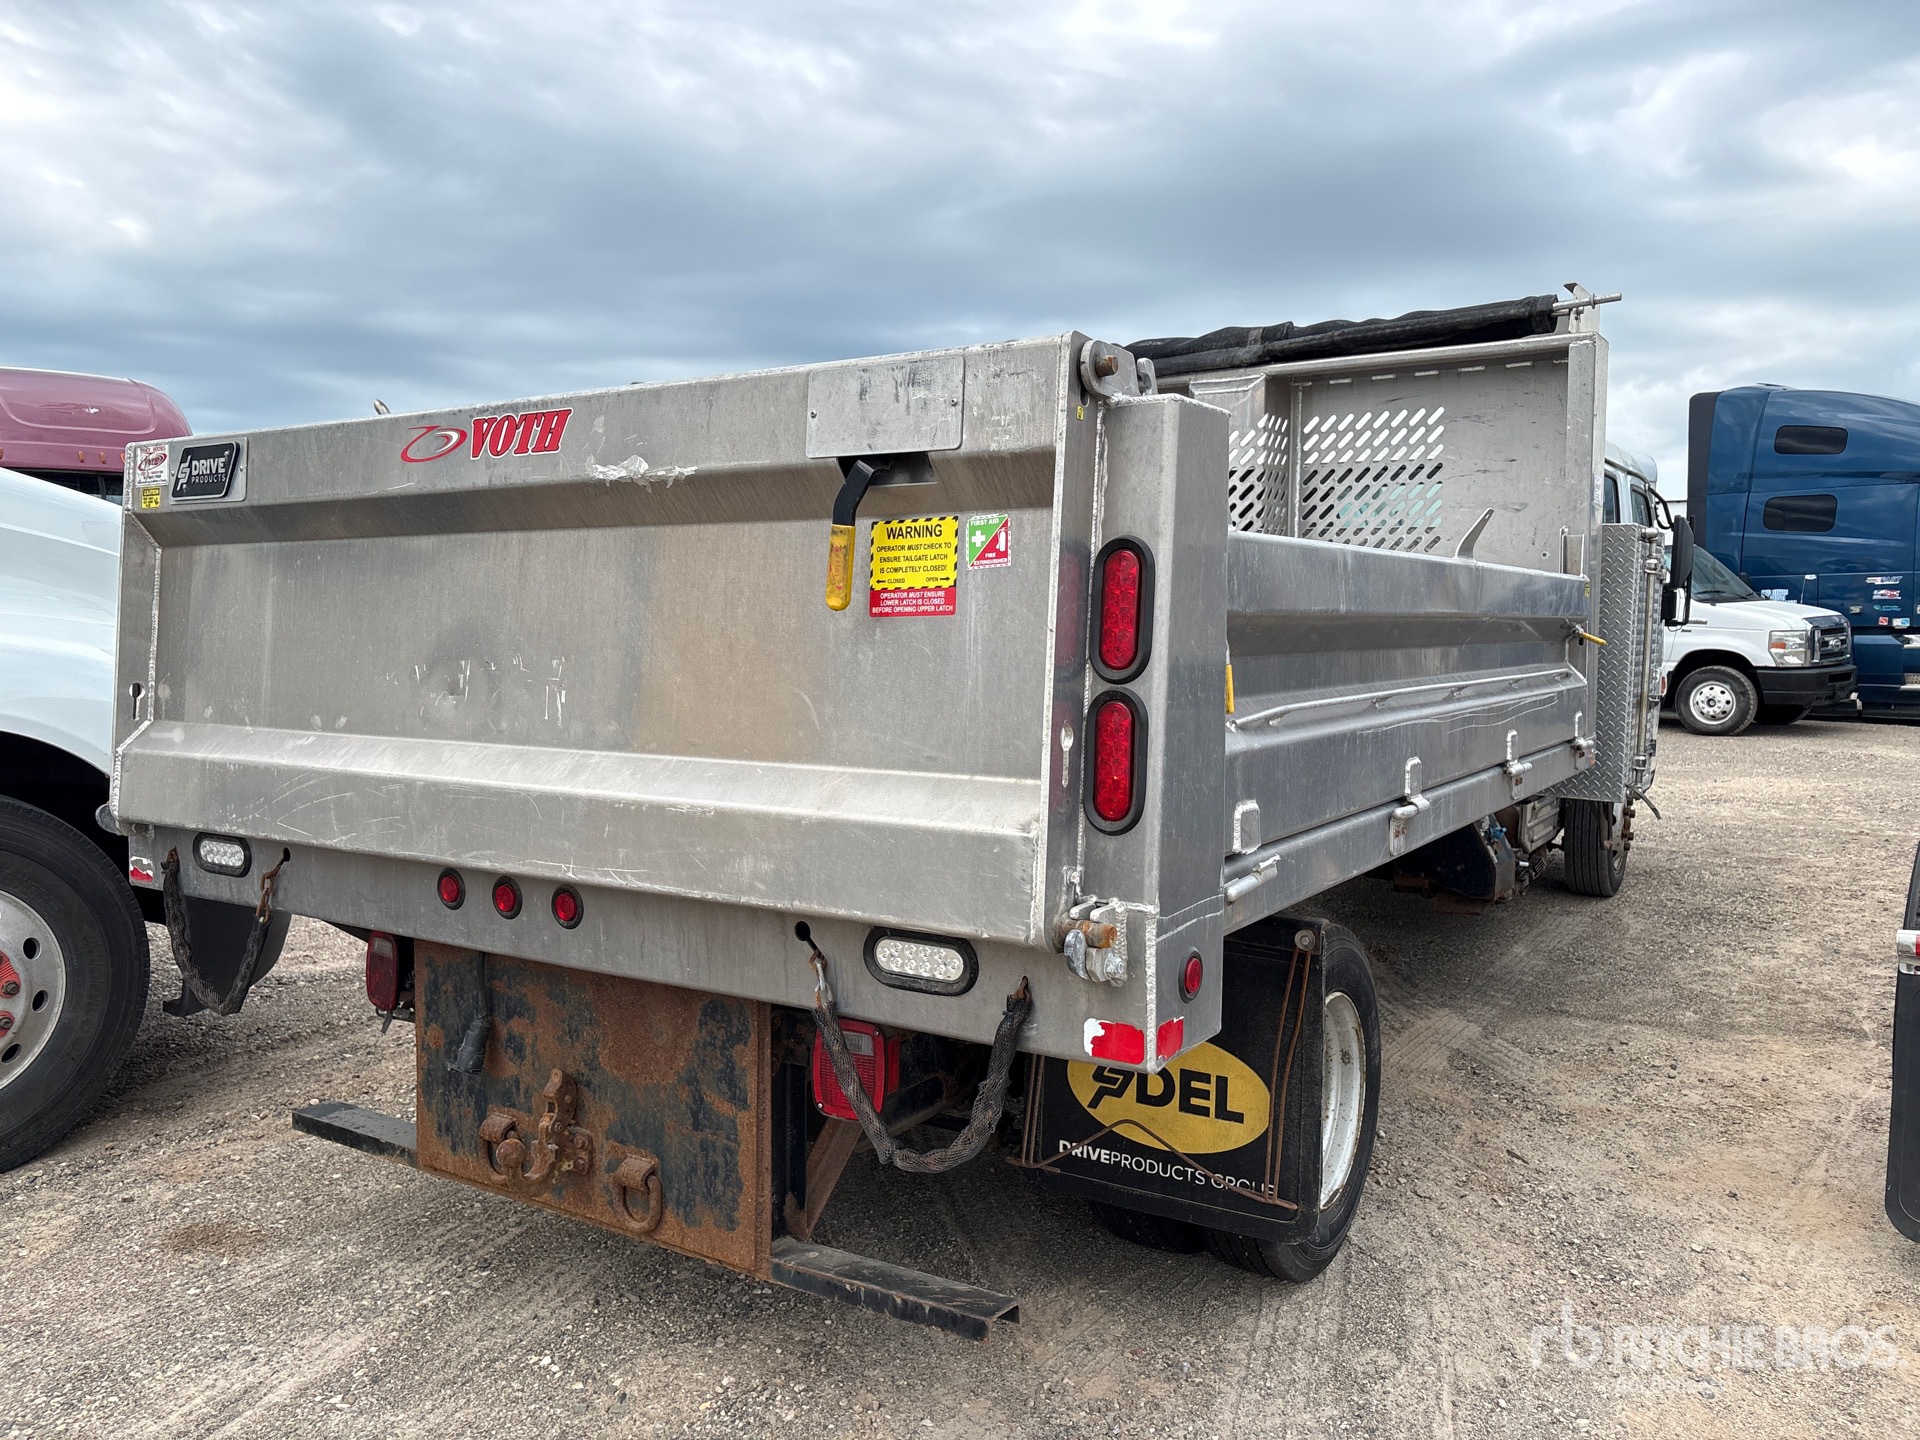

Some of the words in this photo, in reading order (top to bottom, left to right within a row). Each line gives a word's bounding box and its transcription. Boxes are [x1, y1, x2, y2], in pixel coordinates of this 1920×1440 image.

[471, 408, 573, 459] VOTH
[192, 457, 226, 476] DRIVE
[191, 475, 226, 484] PRODUCTS
[886, 524, 943, 540] WARNING
[876, 544, 906, 553] OPERATOR
[907, 543, 923, 551] MUST
[922, 542, 943, 550] CHECK
[944, 541, 952, 549] TO
[879, 555, 902, 564] ENSURE
[902, 554, 929, 562] TAILGATE
[929, 553, 948, 561] LATCH
[885, 565, 922, 574] COMPLETELY
[893, 605, 917, 613] OPENING
[935, 604, 954, 612] LATCH
[1135, 1066, 1245, 1125] DEL
[1058, 1139, 1206, 1185] DRIVEPRODUCTS
